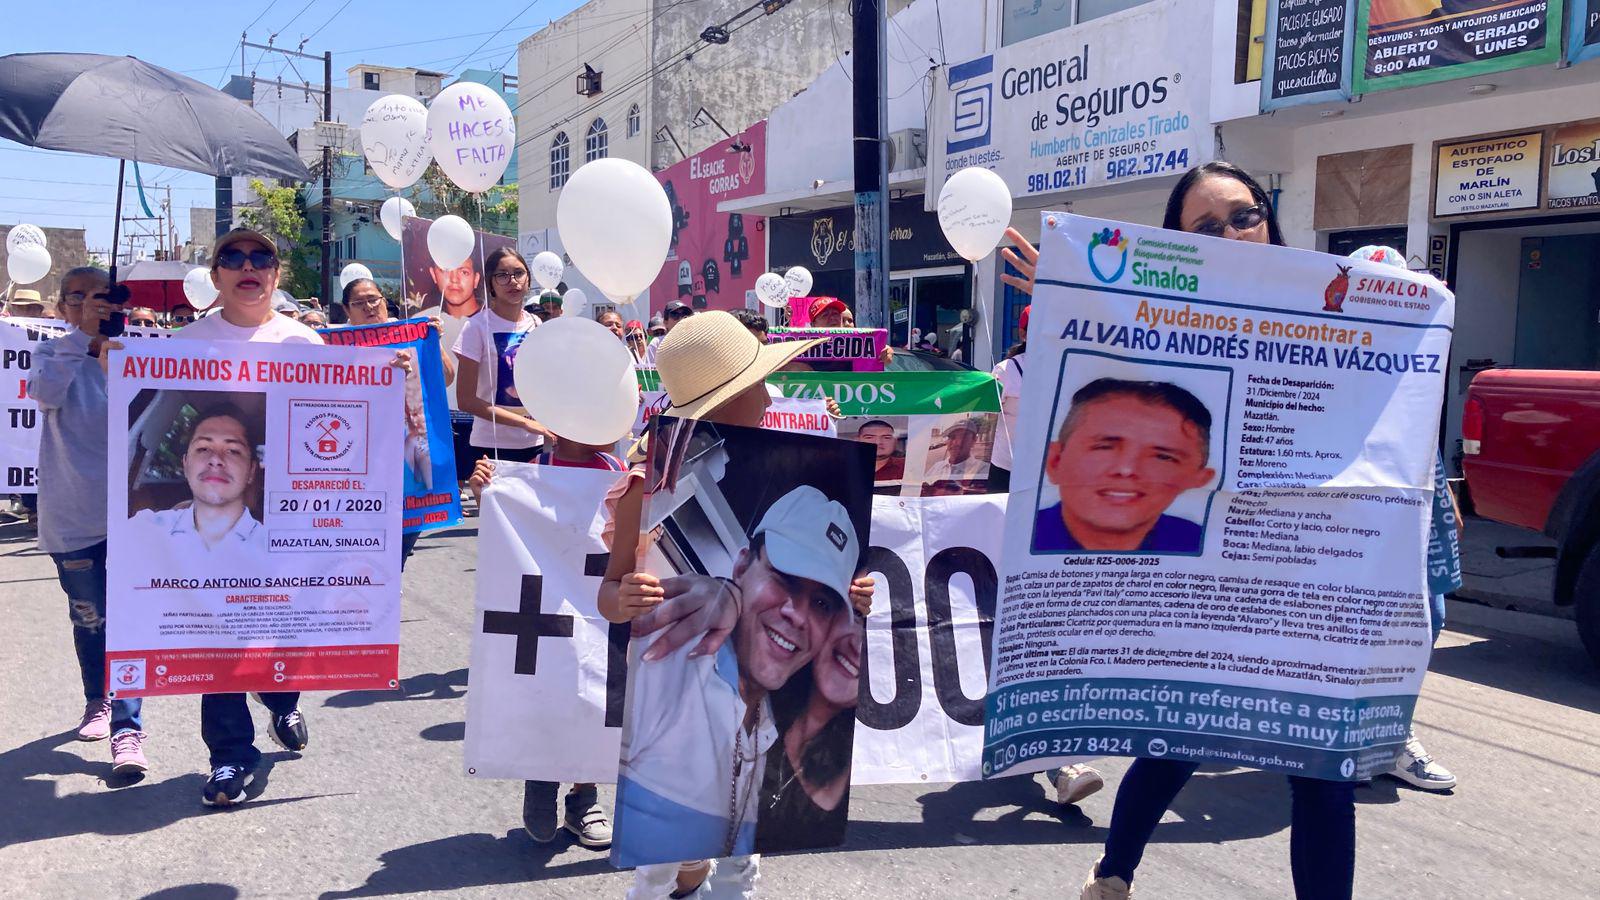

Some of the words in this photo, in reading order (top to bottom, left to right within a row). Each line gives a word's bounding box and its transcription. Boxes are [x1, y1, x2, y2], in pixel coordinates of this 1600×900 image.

[1280, 14, 1300, 32] TACOS
[1300, 12, 1311, 28] DE
[1312, 6, 1343, 26] GUISADO
[1368, 31, 1414, 46] DESAYUNOS
[1420, 24, 1444, 37] TACOS
[1446, 23, 1452, 32] Y
[1452, 14, 1498, 30] ANTOJITOS
[1500, 2, 1546, 20] MEXICANOS
[1464, 18, 1540, 43] CERRADO
[1278, 37, 1298, 48] tacos
[1374, 40, 1438, 60] ABIERTO
[1475, 36, 1528, 56] LUNES
[1278, 52, 1306, 71] TACOS
[1308, 46, 1340, 66] BICHYS
[1374, 60, 1404, 74] 8:00
[1407, 54, 1430, 68] AM
[1001, 44, 1088, 100] General
[1278, 68, 1336, 95] quesadillas
[459, 94, 488, 112] ME
[1032, 111, 1048, 132] de
[1056, 76, 1168, 128] Seguros
[449, 119, 504, 141] HACES
[1030, 136, 1080, 160] Humberto
[1084, 122, 1146, 148] Canizales
[1148, 110, 1190, 136] Tirado
[456, 144, 506, 165] FALTA
[1056, 152, 1090, 167] AGENTE
[1094, 150, 1104, 160] DE
[1109, 140, 1157, 158] SEGUROS
[1451, 140, 1528, 157] AUTENTICO
[1552, 144, 1591, 166] Los
[690, 158, 702, 179] EL
[702, 158, 725, 178] SEACHE
[946, 156, 968, 170] donde
[1452, 152, 1524, 168] ESTOFADO
[1028, 166, 1086, 192] 981.02.11
[1106, 148, 1188, 180] 982.37.44
[1476, 167, 1494, 176] DE
[710, 173, 740, 194] GORRAS
[1460, 176, 1510, 190] MARLÍN
[1448, 194, 1467, 203] CON
[1478, 191, 1492, 200] SIN
[1494, 189, 1522, 198] ALETA
[1548, 198, 1571, 207] TACOS
[1572, 197, 1577, 205] Y
[889, 227, 913, 240] orras
[1168, 242, 1190, 251] Estatal
[1132, 262, 1198, 292] Sinaloa
[1356, 278, 1428, 298] SINALOA
[1349, 296, 1386, 306] GOBIERNO
[1404, 302, 1430, 310] ESTADO
[1136, 300, 1238, 332] Ayudanos
[1242, 320, 1254, 334] a
[1258, 318, 1356, 346] encontrar
[1361, 332, 1372, 346] a
[1060, 318, 1161, 352] ALVARO
[1164, 330, 1249, 361] ANDRÉS
[1255, 340, 1328, 368] RIVERA
[1334, 346, 1440, 375] VÁZQUEZ
[123, 356, 232, 382] AYUDANOS
[237, 362, 250, 382] A
[256, 361, 392, 386] ENCONTRARLO
[17, 380, 34, 399] J
[1248, 375, 1270, 385] Fecha
[1271, 377, 1281, 385] de
[1282, 378, 1334, 390] Desaparición:
[1246, 387, 1256, 395] 31
[1302, 392, 1320, 400] 2024
[1245, 399, 1284, 410] Municipio
[1285, 402, 1297, 411] del
[1298, 403, 1324, 412] hecho:
[8, 408, 36, 428] TU
[1244, 411, 1279, 422] Mazatlán.
[1243, 422, 1264, 432] Sexo:
[1265, 424, 1295, 434] Hombre
[1241, 434, 1264, 443] Edad:
[1265, 436, 1274, 444] 47
[1276, 437, 1294, 446] años
[1240, 446, 1275, 456] Estatura:
[1277, 449, 1293, 457] 1.60
[1295, 450, 1313, 458] mts.
[1315, 450, 1342, 460] Aprox.
[1239, 458, 1254, 466] Tez:
[1255, 459, 1287, 469] Moreno
[292, 479, 350, 490] DESAPARECIÓ
[352, 480, 365, 490] EL:
[280, 500, 298, 512] 20
[303, 500, 308, 512] /
[313, 500, 330, 512] 01
[336, 500, 341, 512] /
[346, 499, 382, 512] 2020
[312, 518, 344, 528] LUGAR:
[1443, 512, 1455, 524] o
[271, 538, 333, 549] MAZATLAN,
[336, 537, 380, 547] SINALOA
[1064, 557, 1095, 566] Cedula:
[1096, 557, 1160, 566] RZS-0006-2025
[1430, 558, 1448, 577] Si
[150, 578, 200, 589] MARCO
[203, 577, 261, 588] ANTONIO
[265, 576, 325, 587] SANCHEZ
[328, 576, 371, 586] OSUNA
[168, 674, 214, 684] 6692476738
[996, 694, 1007, 713] Si
[1009, 686, 1059, 708] tienes
[1064, 682, 1183, 703] información
[1190, 687, 1292, 715] referente
[1298, 704, 1310, 718] a
[1317, 706, 1356, 722] esta
[1358, 703, 1403, 724] persona,
[989, 713, 1023, 738] llama
[1027, 712, 1038, 724] o
[1041, 702, 1149, 723] escribenos.
[1154, 705, 1178, 724] Tu
[1184, 711, 1251, 731] ayuda
[1258, 720, 1281, 734] es
[1288, 724, 1338, 747] muy
[1344, 722, 1406, 746] importante.
[1019, 739, 1048, 758] 669
[1051, 738, 1082, 753] 327
[1087, 737, 1133, 753] 8424
[1171, 744, 1304, 770] cebpd@sinaloa.gob.mx
